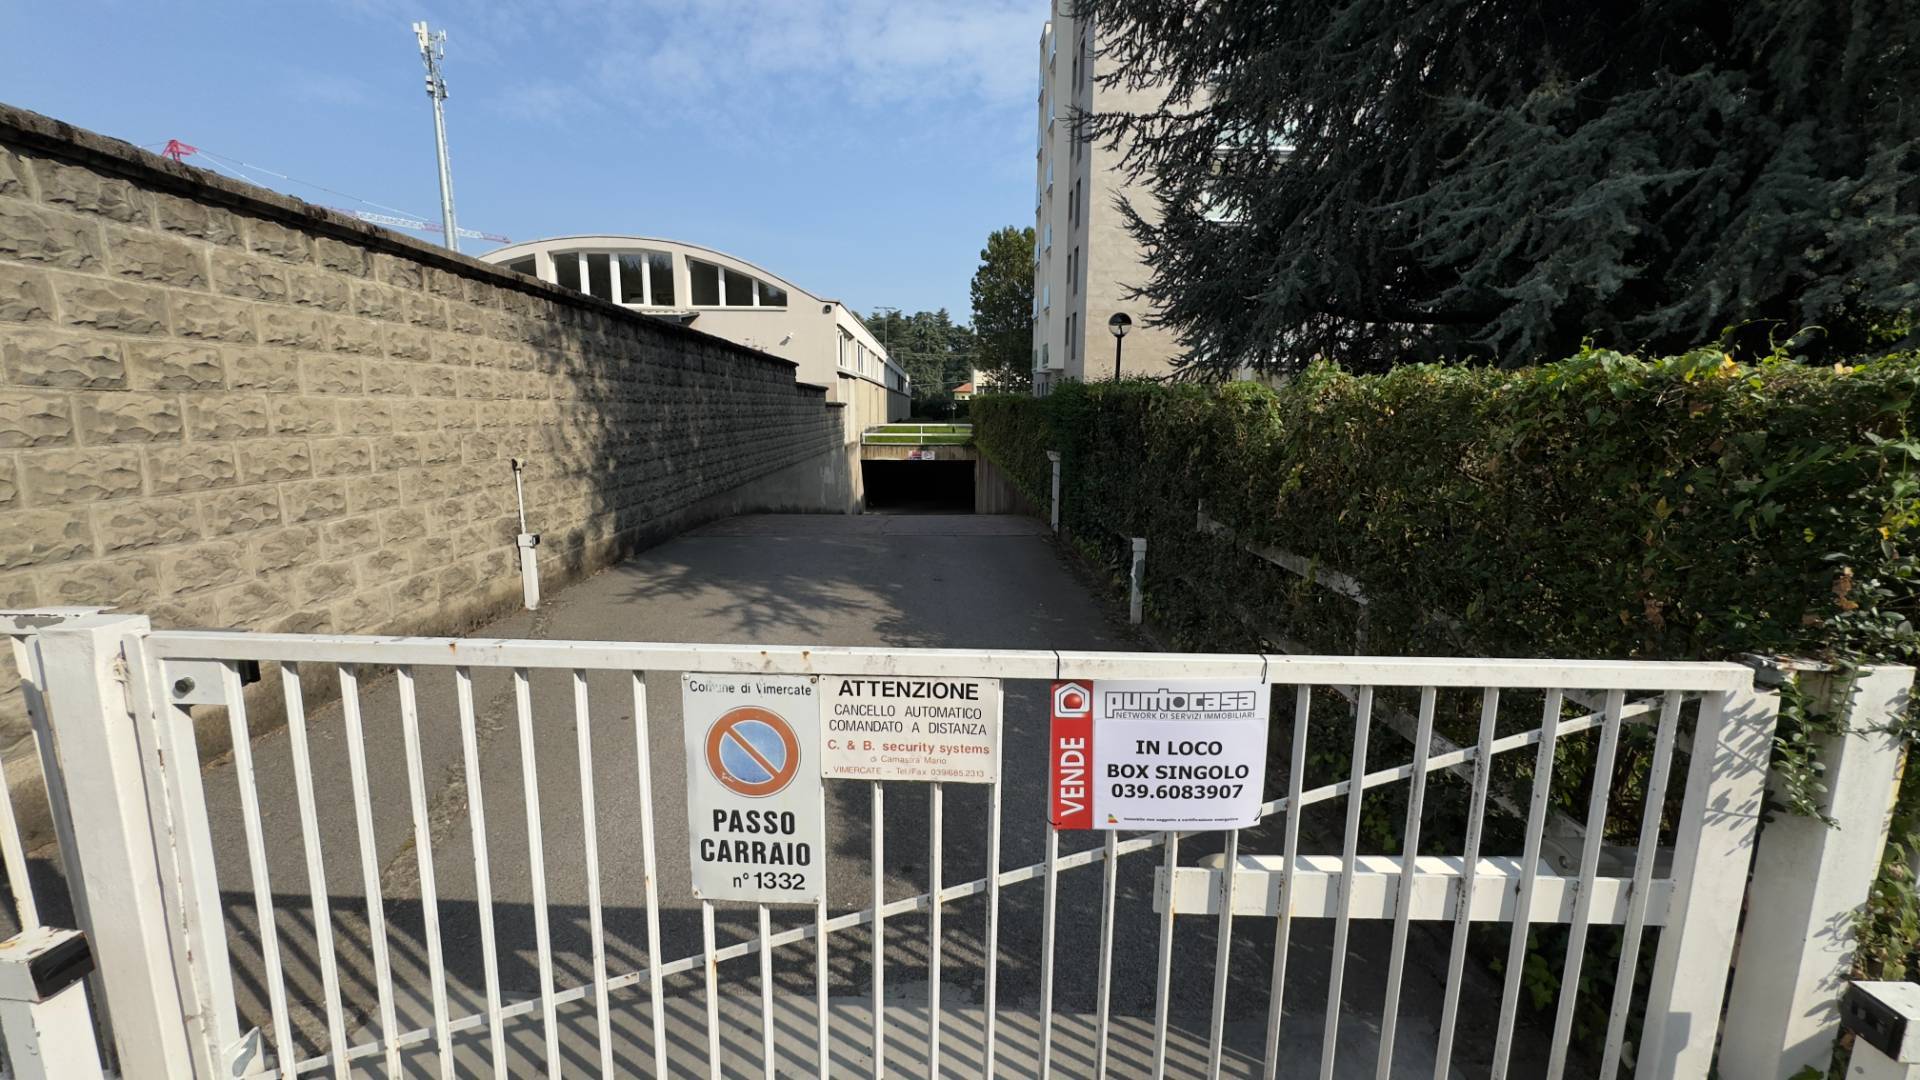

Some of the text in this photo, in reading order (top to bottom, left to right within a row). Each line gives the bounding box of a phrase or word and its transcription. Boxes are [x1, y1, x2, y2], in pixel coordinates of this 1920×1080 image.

[741, 683, 750, 694] di
[839, 680, 979, 701] ATTENZIONE
[834, 703, 982, 719] CANCELLO AUTOMATICO
[1116, 711, 1255, 720] NETWORK DI SERVIZI IMMOBILIARI
[829, 719, 987, 735] COMANDATO A DISTANZA
[827, 739, 990, 756] C. & B. security systems
[1135, 740, 1223, 756] IN LOCO
[833, 766, 881, 775] VIMERCATE
[1060, 737, 1085, 817] VENDE
[1107, 764, 1249, 780] BOX SINGOLO
[1111, 783, 1244, 800] 039.6083907
[713, 809, 795, 835] PASSO
[700, 838, 811, 866] CARRAIO
[754, 872, 806, 890] 1332
